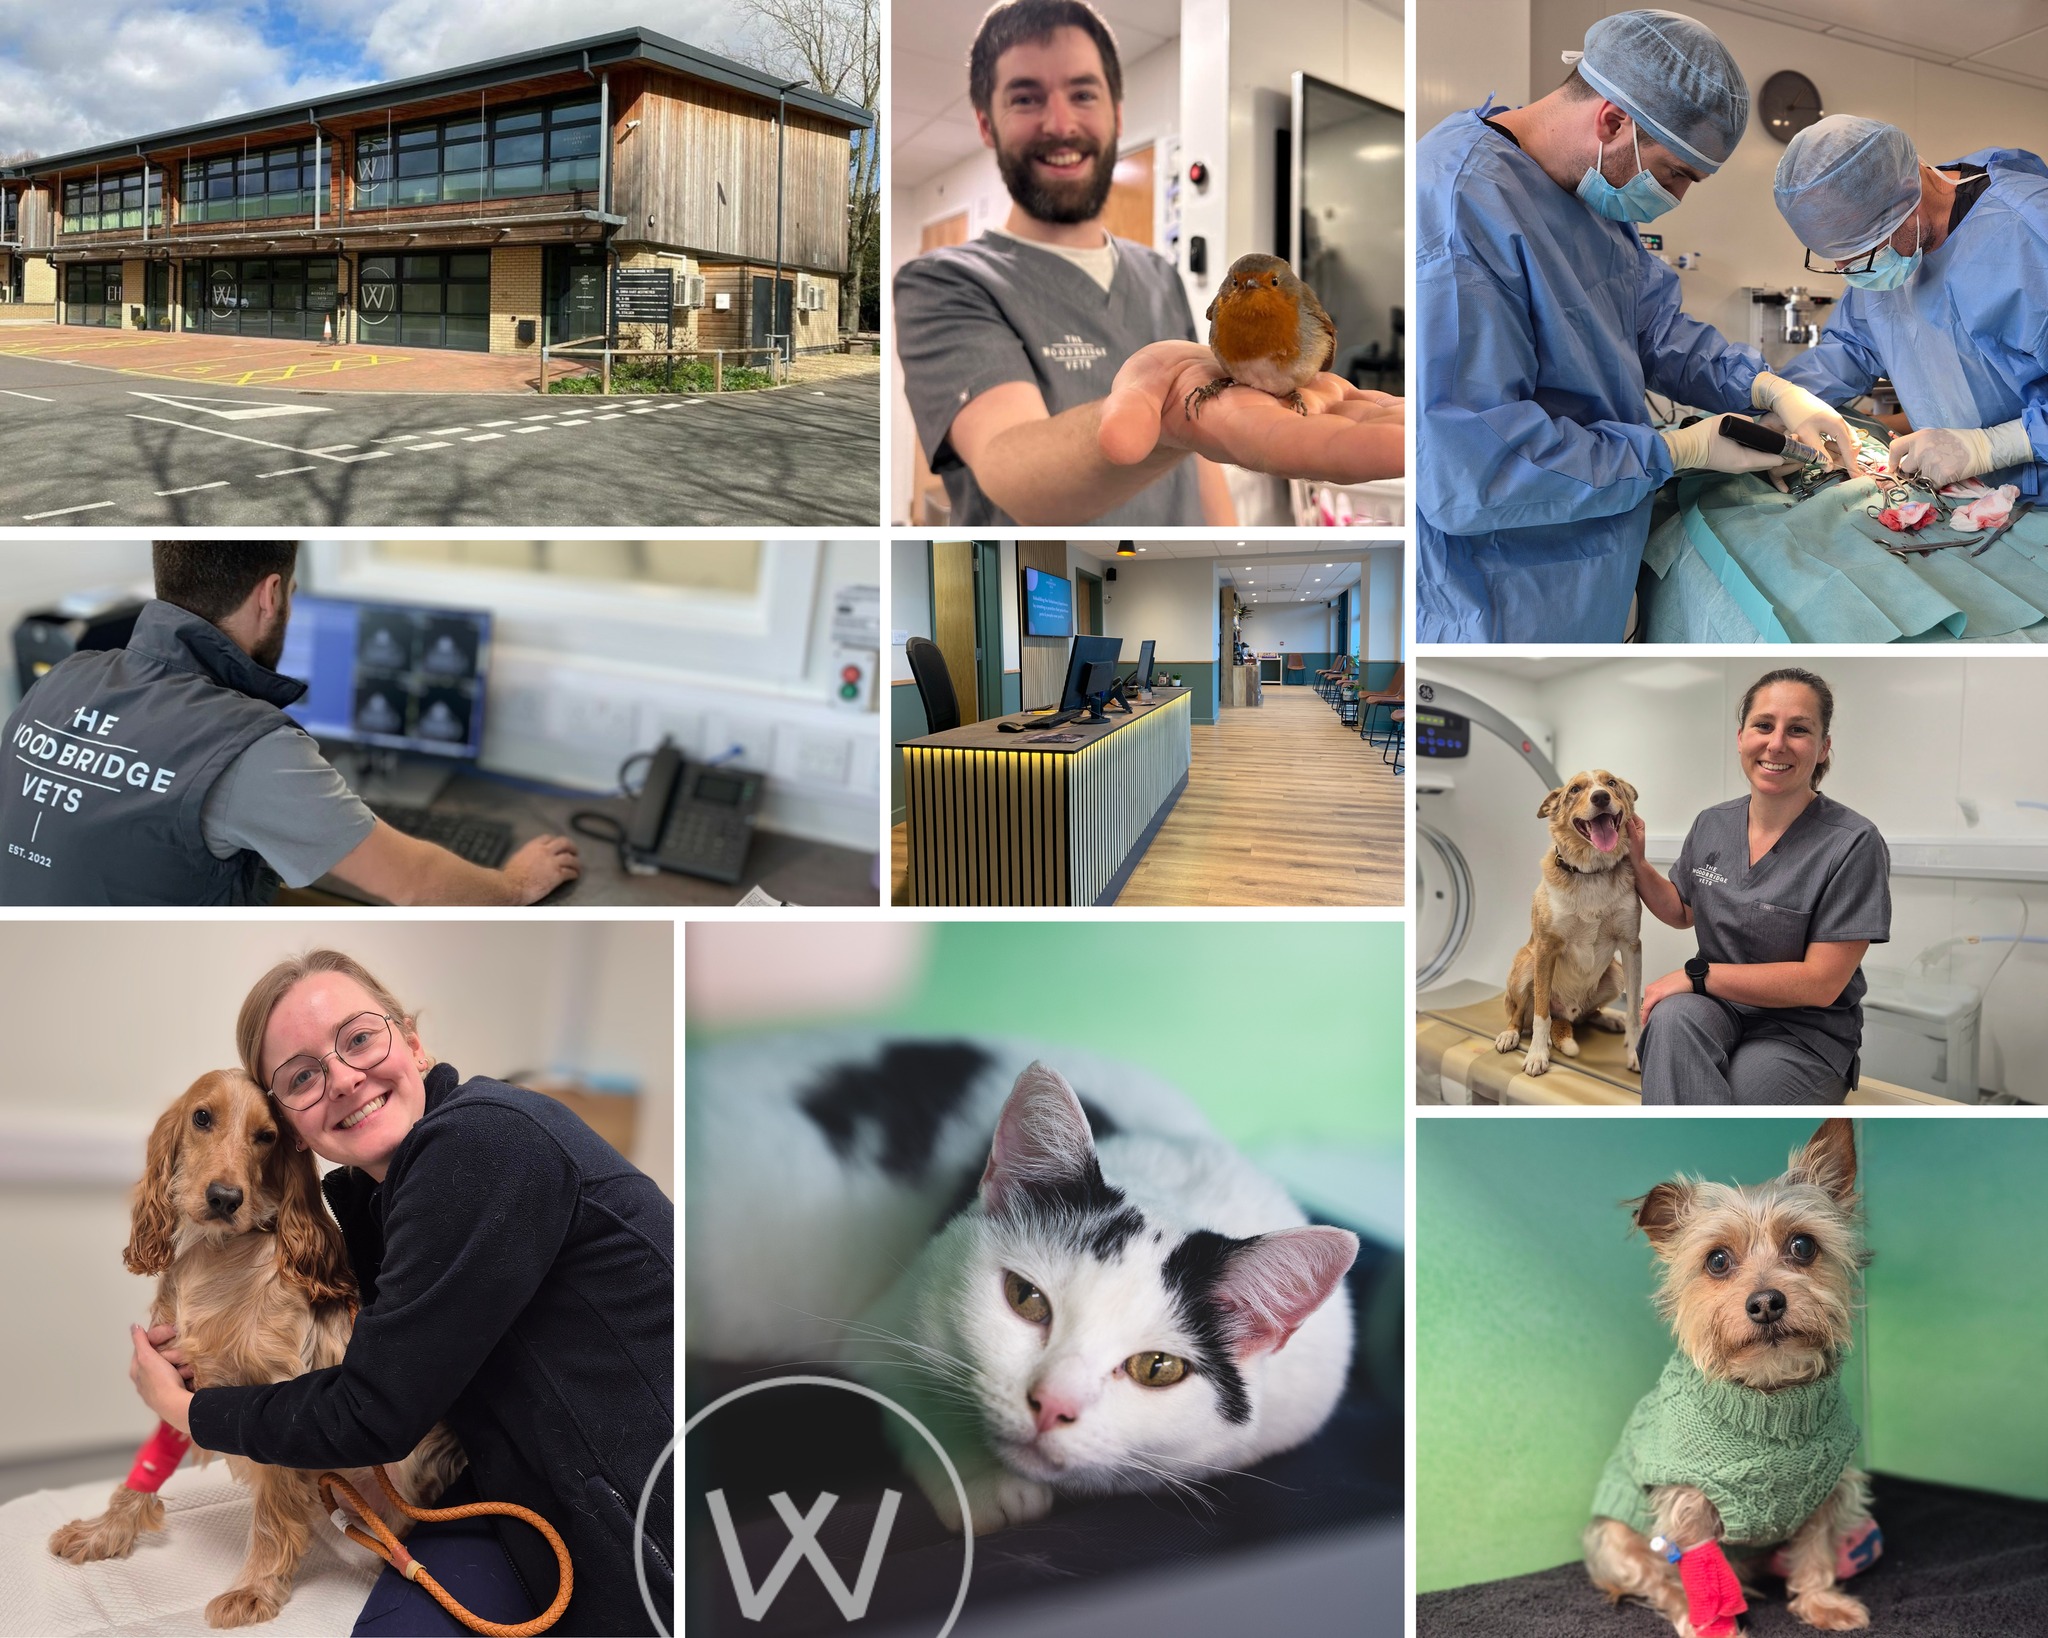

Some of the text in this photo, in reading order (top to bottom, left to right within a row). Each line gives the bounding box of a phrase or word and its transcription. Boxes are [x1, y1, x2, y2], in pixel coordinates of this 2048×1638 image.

[107, 285, 122, 301] EH
[213, 285, 231, 305] W
[361, 286, 386, 309] W
[22, 773, 83, 813] VETS
[8, 843, 52, 868] EST. 2022
[1705, 863, 1718, 872] THE
